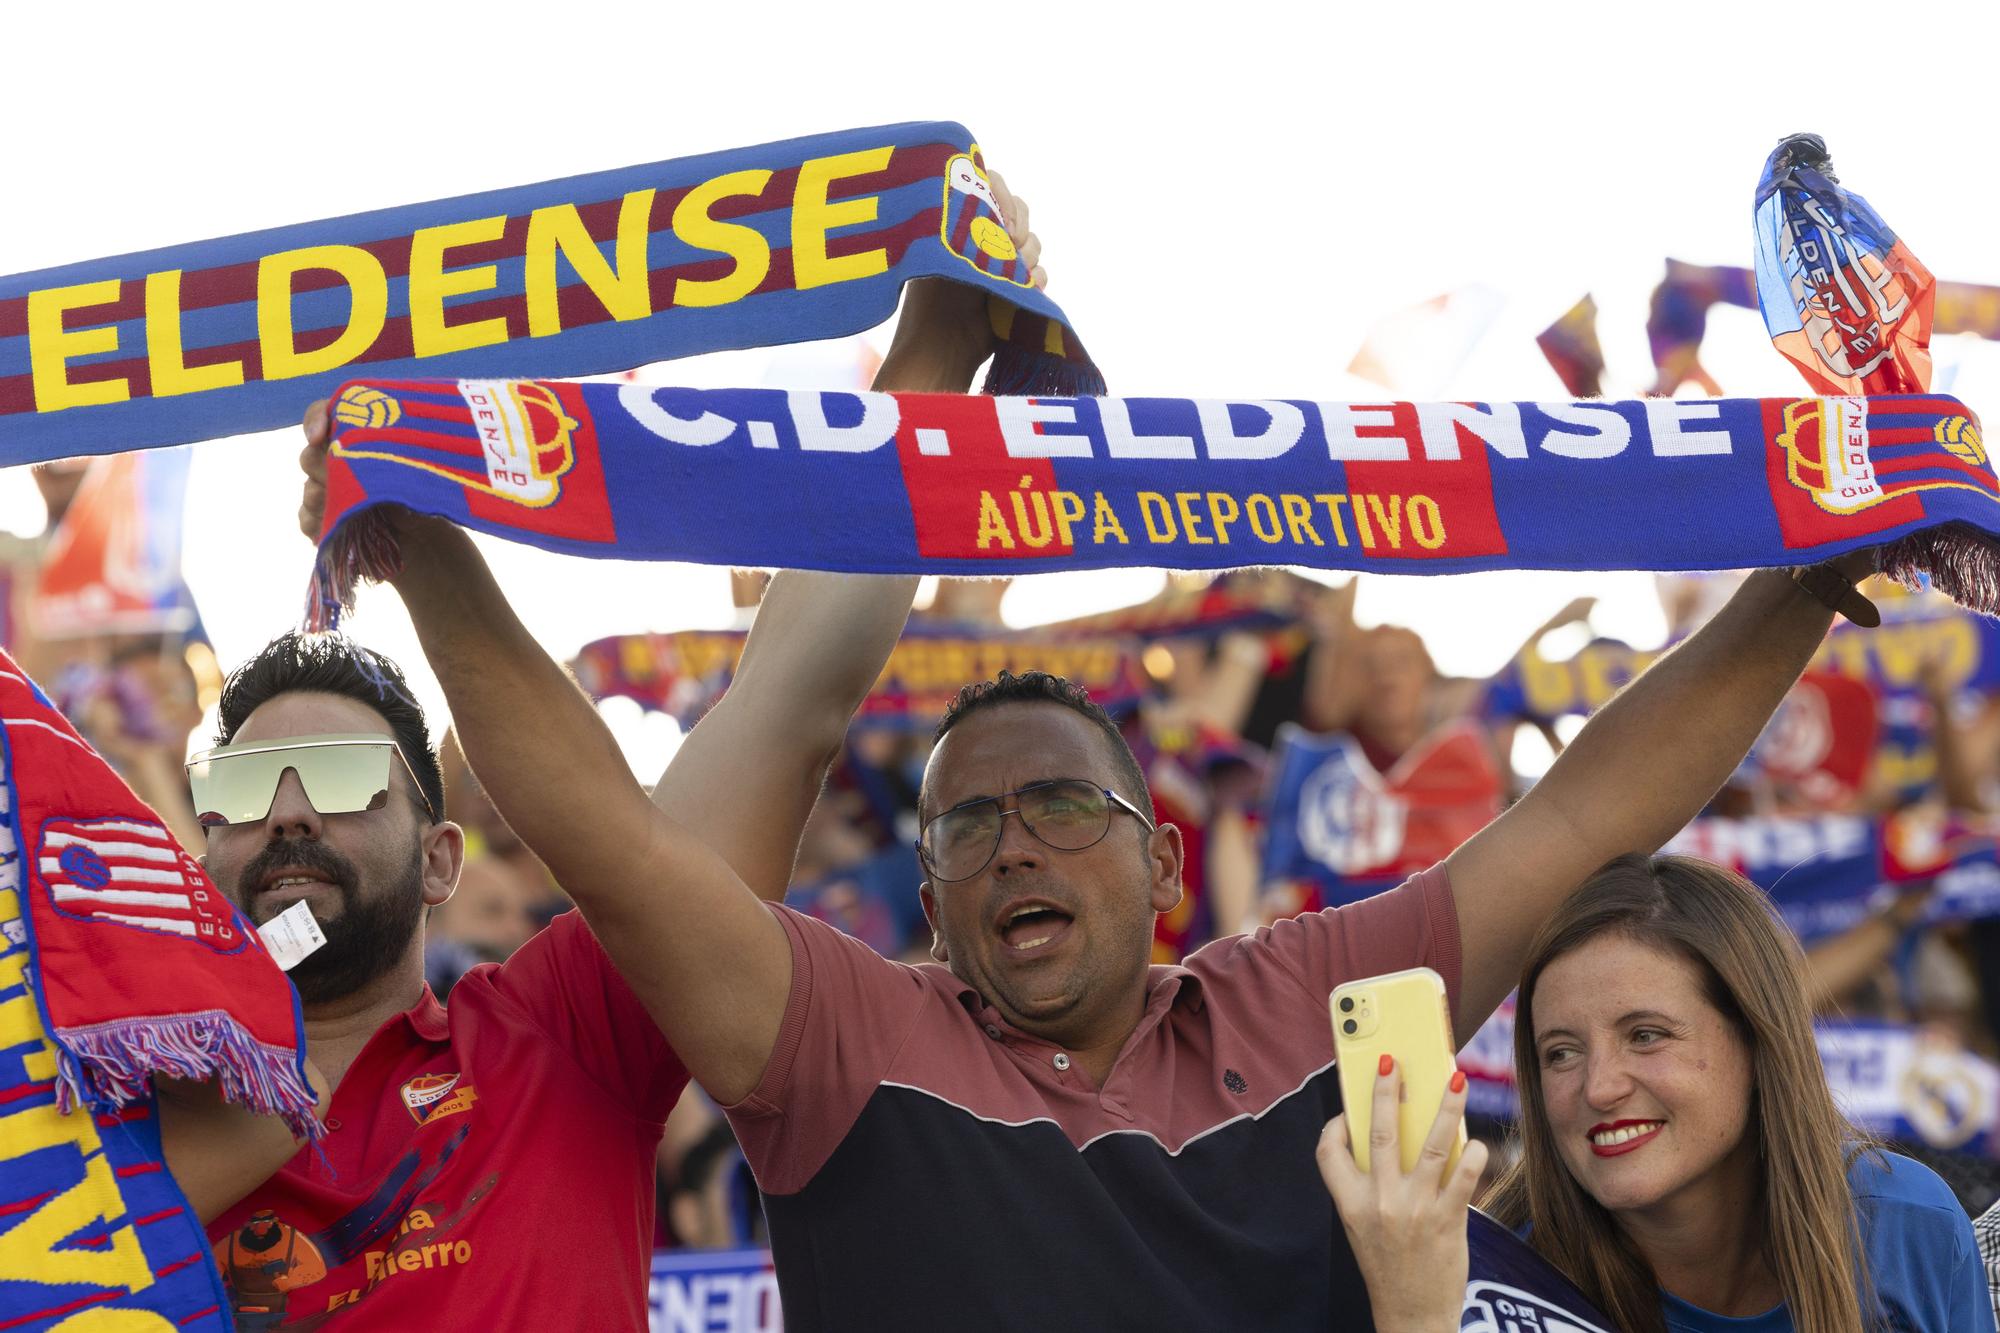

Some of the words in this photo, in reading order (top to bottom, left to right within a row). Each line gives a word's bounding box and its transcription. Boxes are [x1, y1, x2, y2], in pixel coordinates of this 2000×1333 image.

[27, 145, 896, 413] ELDENSE
[466, 382, 509, 483] DENSE
[617, 384, 951, 456] C.D.
[994, 396, 1733, 459] ELDENSE
[975, 475, 1129, 550] AÚPA
[1143, 490, 1448, 551] DEPORTIVO
